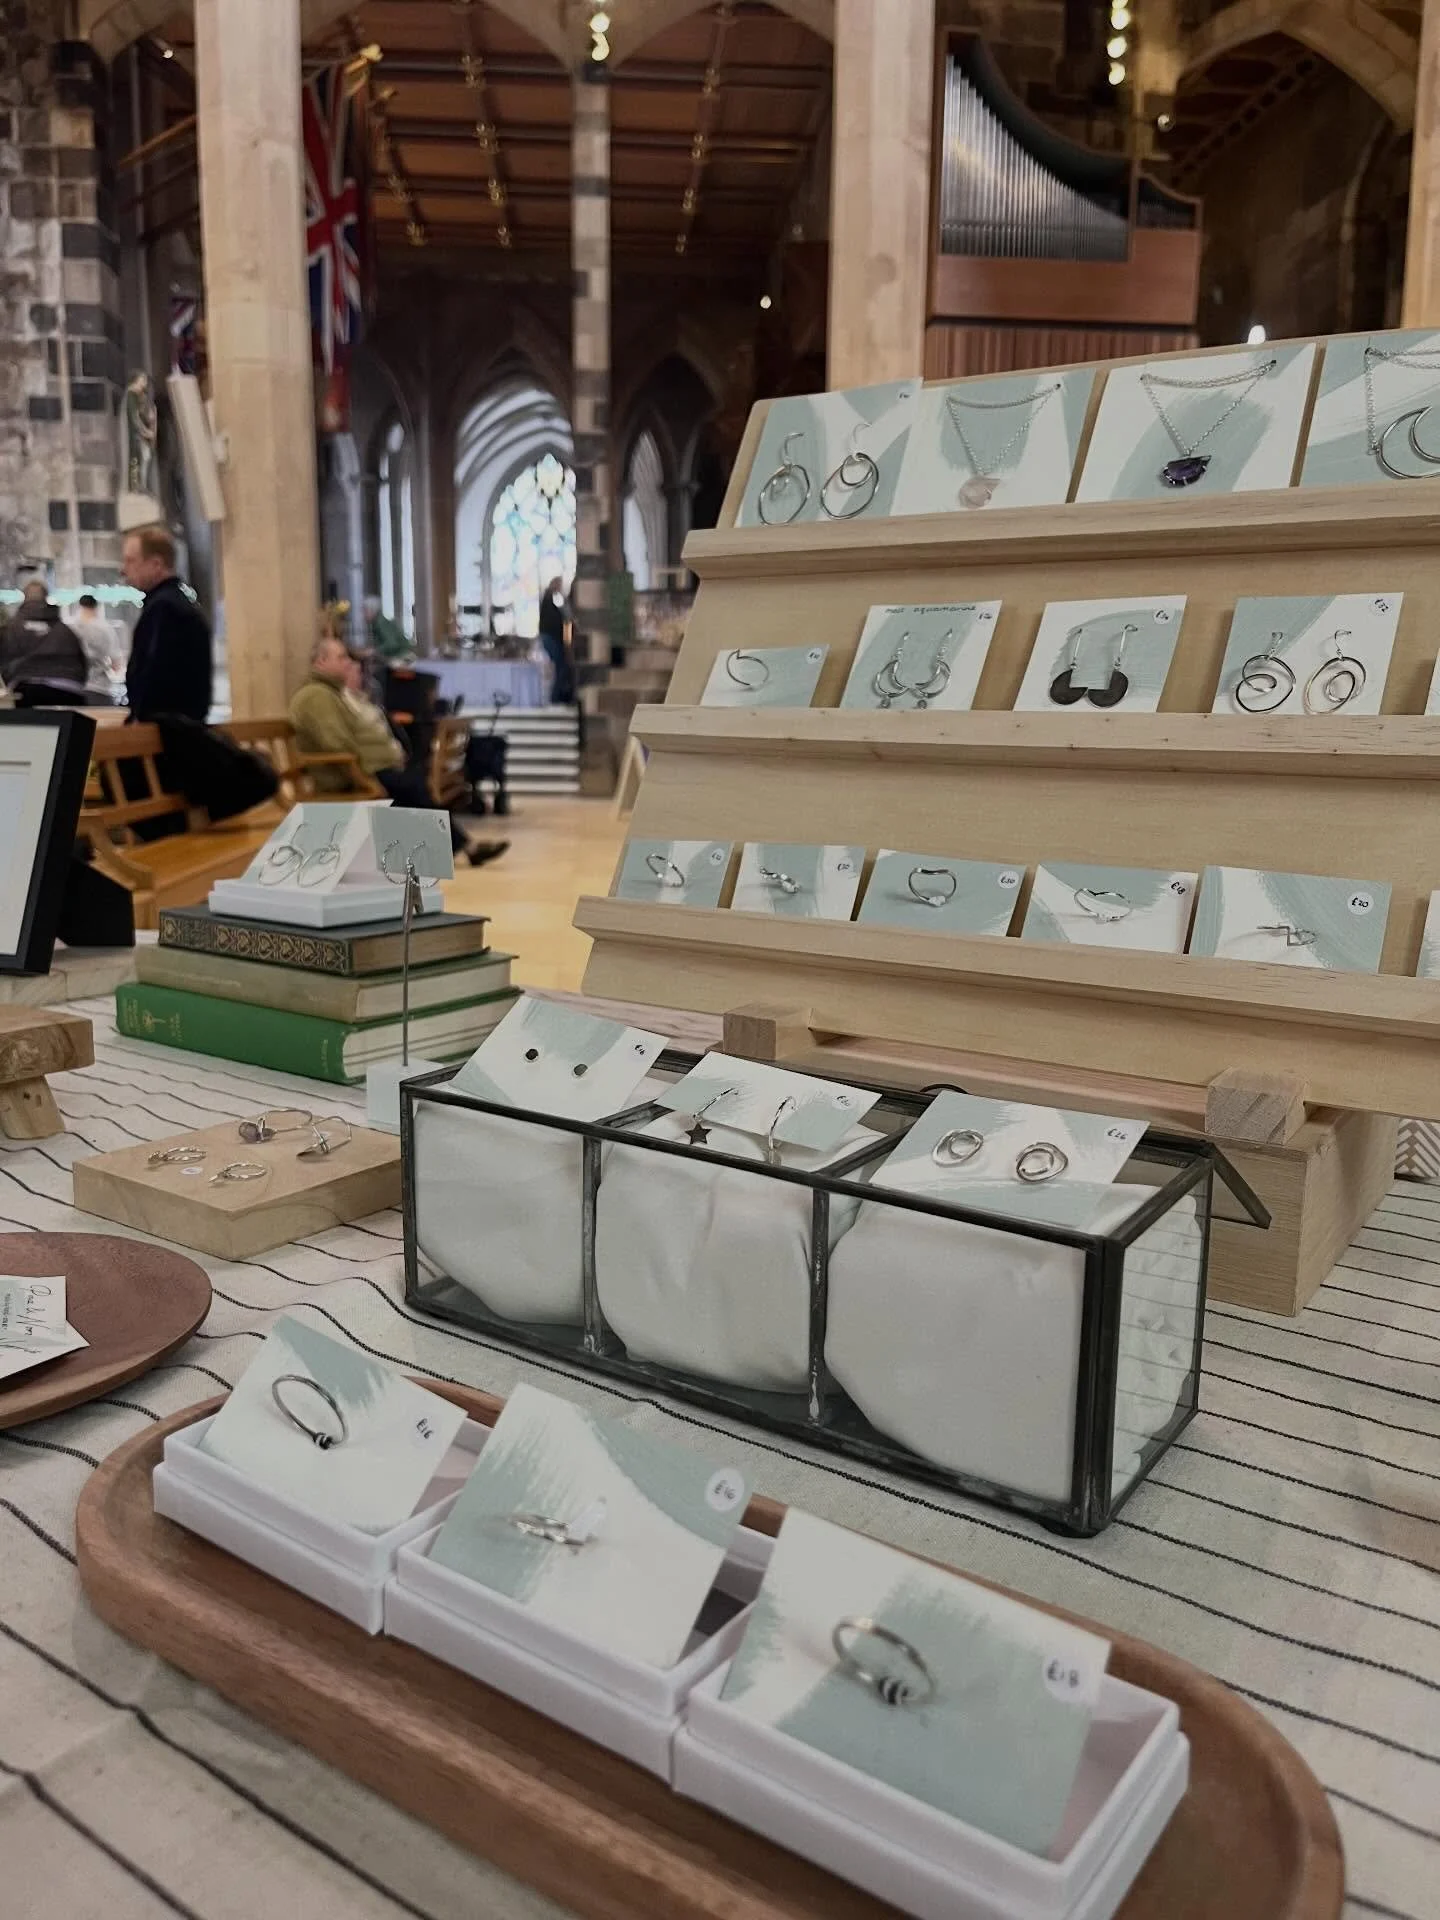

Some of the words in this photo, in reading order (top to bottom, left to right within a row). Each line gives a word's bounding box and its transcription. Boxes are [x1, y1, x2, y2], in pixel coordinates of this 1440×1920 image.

[1170, 881, 1186, 895] £18
[1351, 897, 1369, 908] £20
[1107, 1128, 1128, 1140] £26
[416, 1418, 434, 1440] £16
